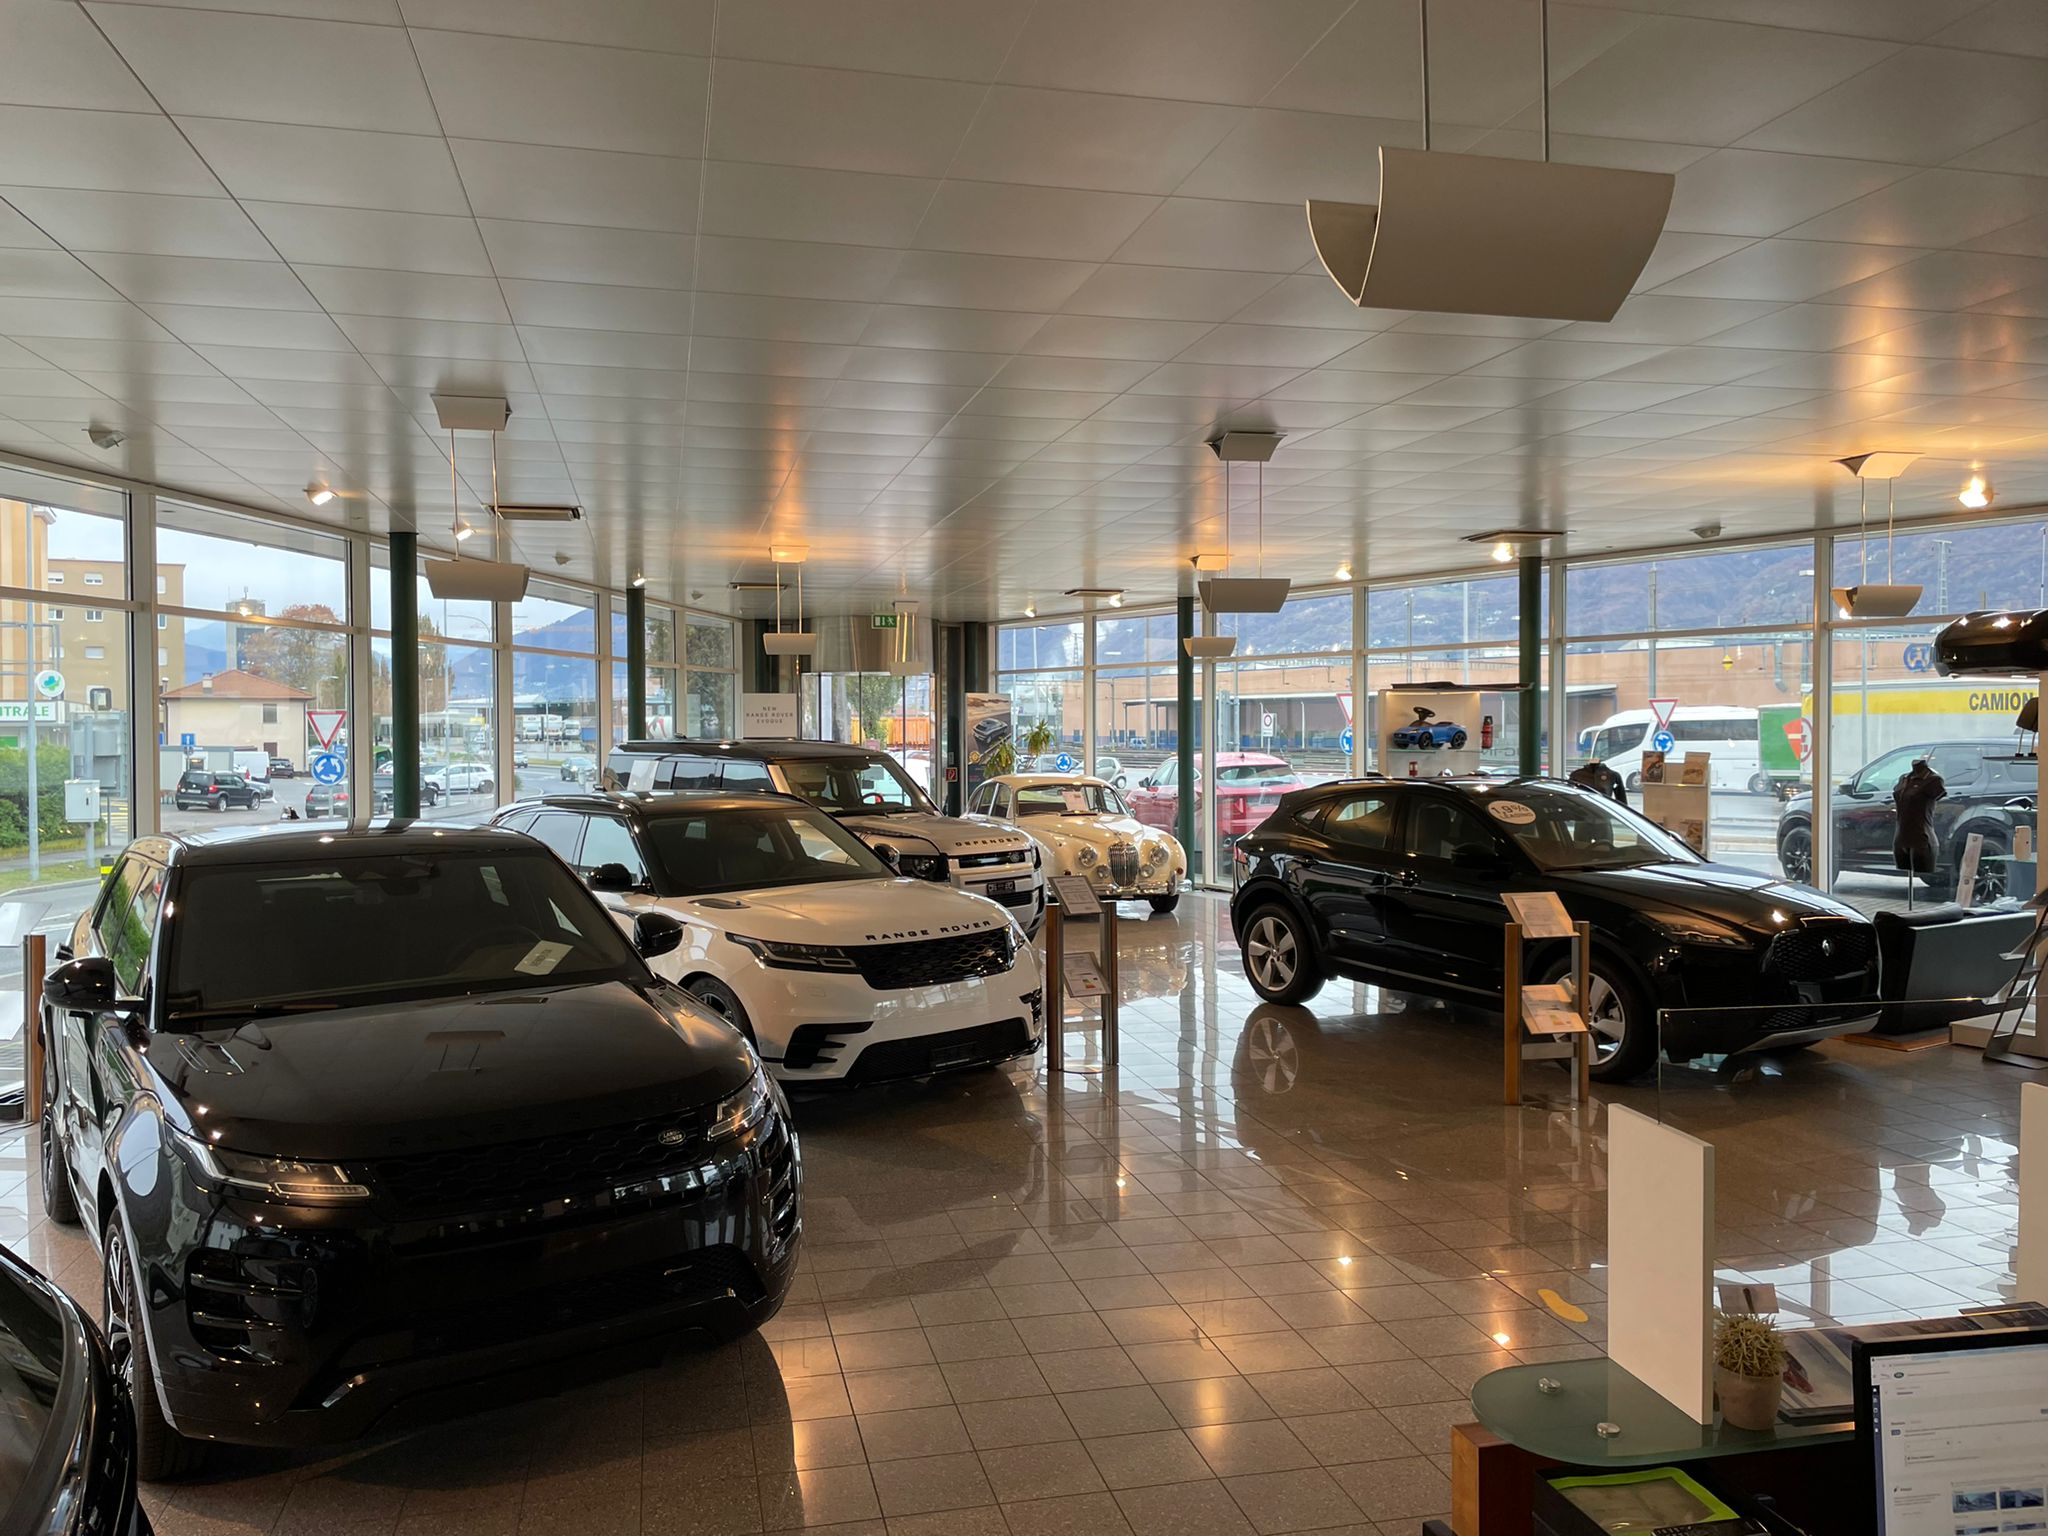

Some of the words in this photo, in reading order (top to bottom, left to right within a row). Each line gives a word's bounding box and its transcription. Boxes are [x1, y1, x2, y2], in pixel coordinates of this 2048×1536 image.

[0, 706, 49, 717] TRALE
[865, 929, 930, 941] RANGE
[939, 920, 991, 934] ROVER
